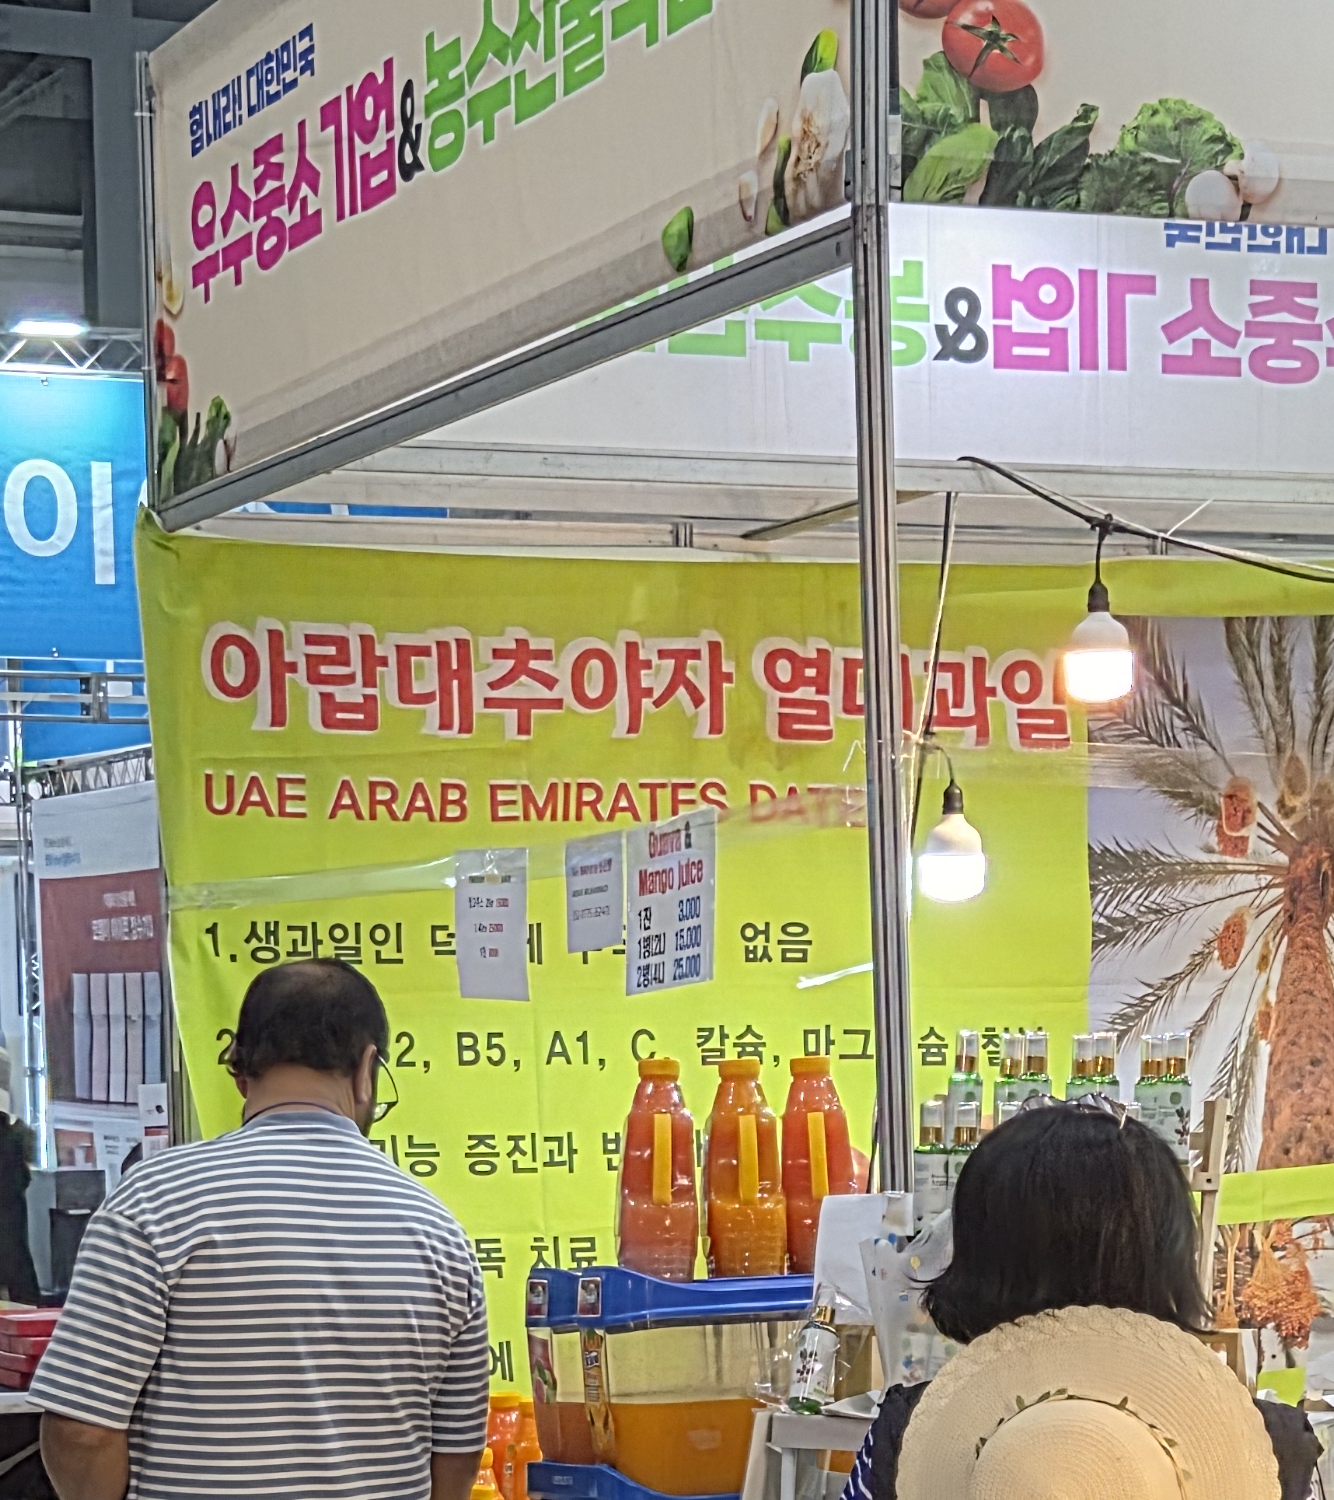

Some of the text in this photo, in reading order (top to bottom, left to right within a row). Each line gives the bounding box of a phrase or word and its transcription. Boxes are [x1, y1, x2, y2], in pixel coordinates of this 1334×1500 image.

[190, 23, 315, 157] 힘내라! 대한민국
[208, 624, 734, 738] 아랍대추야자
[203, 773, 730, 824] UAE ARAB EMIRATES
[638, 866, 675, 897] Mango
[740, 921, 814, 964] 없음
[456, 1031, 522, 1073] B5,
[546, 1030, 608, 1073] A1,
[464, 1132, 579, 1177] 증진과
